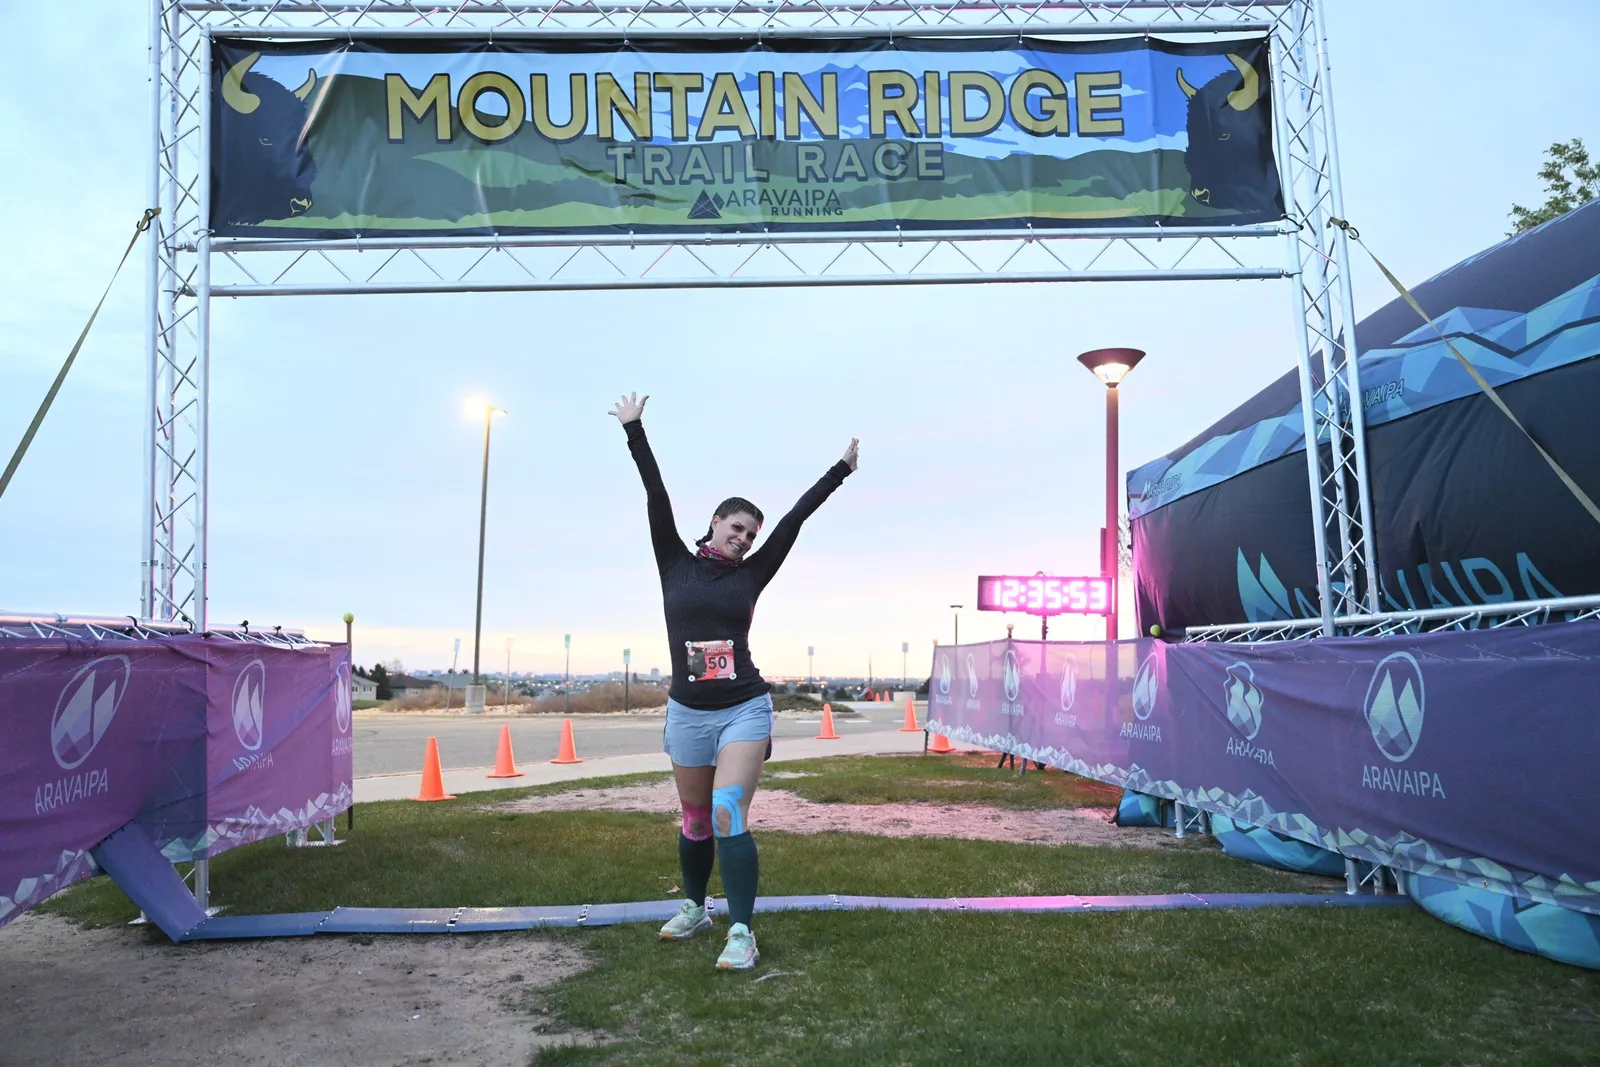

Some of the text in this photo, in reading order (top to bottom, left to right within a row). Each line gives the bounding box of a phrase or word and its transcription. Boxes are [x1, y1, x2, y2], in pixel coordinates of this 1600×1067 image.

[385, 68, 1125, 143] MOUNTAIN RIDGE
[606, 141, 945, 185] TRAIL RACE
[725, 189, 841, 208] ARAVAIPA
[771, 206, 843, 217] RUNNING
[993, 579, 1108, 609] 12:35:53
[708, 656, 727, 670] 50
[1119, 721, 1162, 742] ARAVAIPA
[35, 768, 108, 815] ARAVAIPA
[1362, 764, 1446, 799] ARAVAIPA
